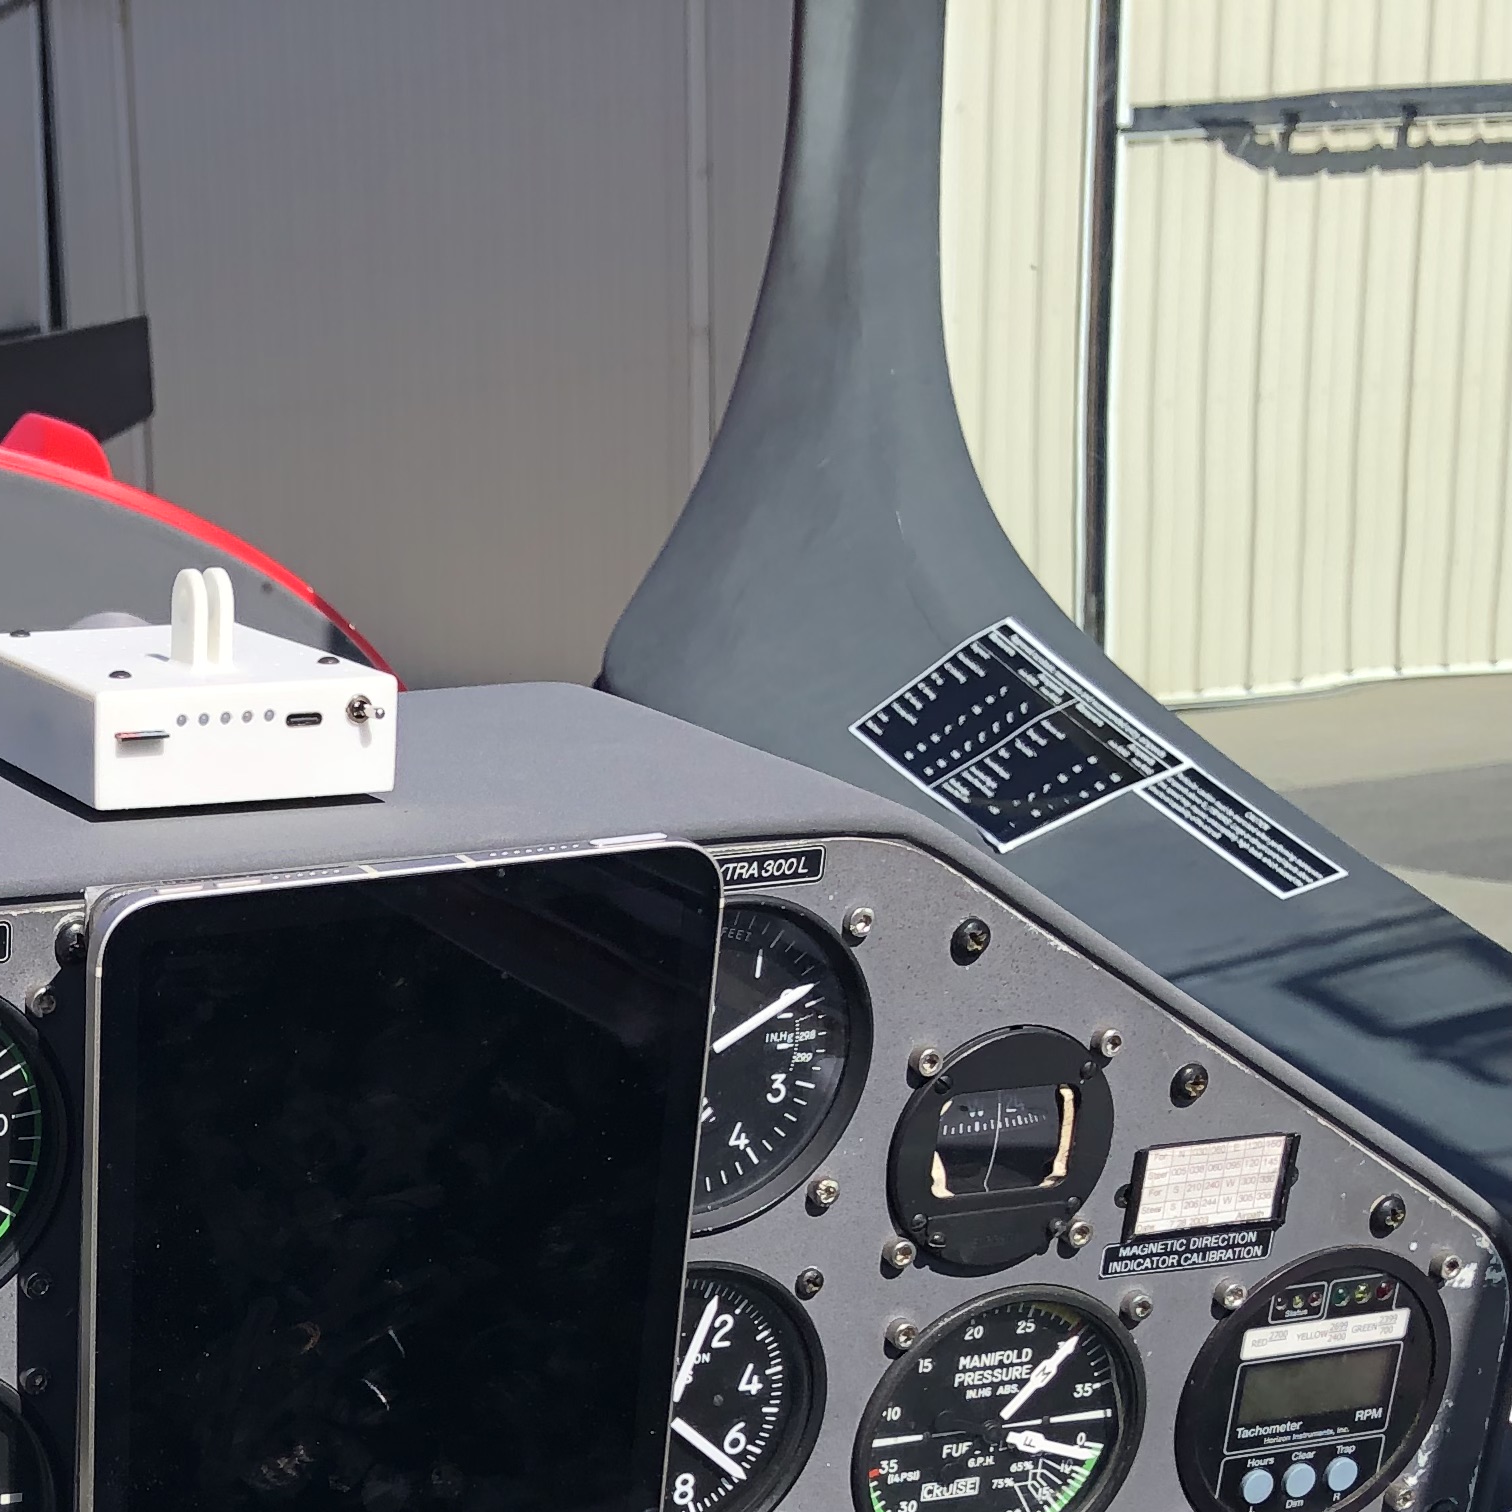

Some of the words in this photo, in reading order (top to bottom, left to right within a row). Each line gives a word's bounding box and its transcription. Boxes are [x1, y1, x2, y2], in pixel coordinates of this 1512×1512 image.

[720, 861, 759, 880] TRA
[761, 856, 808, 877] 300L
[766, 1073, 786, 1103] 3
[729, 1122, 749, 1150] 4
[1119, 1238, 1186, 1257] MAGNETIC
[1190, 1232, 1257, 1251] DIRECTION
[1108, 1255, 1177, 1273] INDICATOR
[1181, 1245, 1263, 1266] CALIBRATION
[711, 1314, 734, 1348] 2
[964, 1325, 984, 1340] 20
[1016, 1320, 1036, 1335] 25
[1297, 1330, 1327, 1341] YELLOW
[1352, 1323, 1377, 1333] GREEN
[1380, 1326, 1393, 1335] 700
[1251, 1339, 1267, 1347] RED
[919, 1358, 933, 1373] 15
[959, 1348, 1032, 1370] MANIFOLD
[738, 1363, 763, 1395] 4
[954, 1364, 1033, 1387] PRESSURE
[1074, 1383, 1093, 1397] 35
[886, 1406, 901, 1421] 10
[1355, 1408, 1383, 1421] RPM
[724, 1421, 746, 1455] 6
[1236, 1421, 1303, 1438] Tachometer
[1291, 1450, 1316, 1462] Clear
[879, 1460, 898, 1473] 35
[673, 1473, 695, 1505] 8
[922, 1479, 977, 1499] CRUISE
